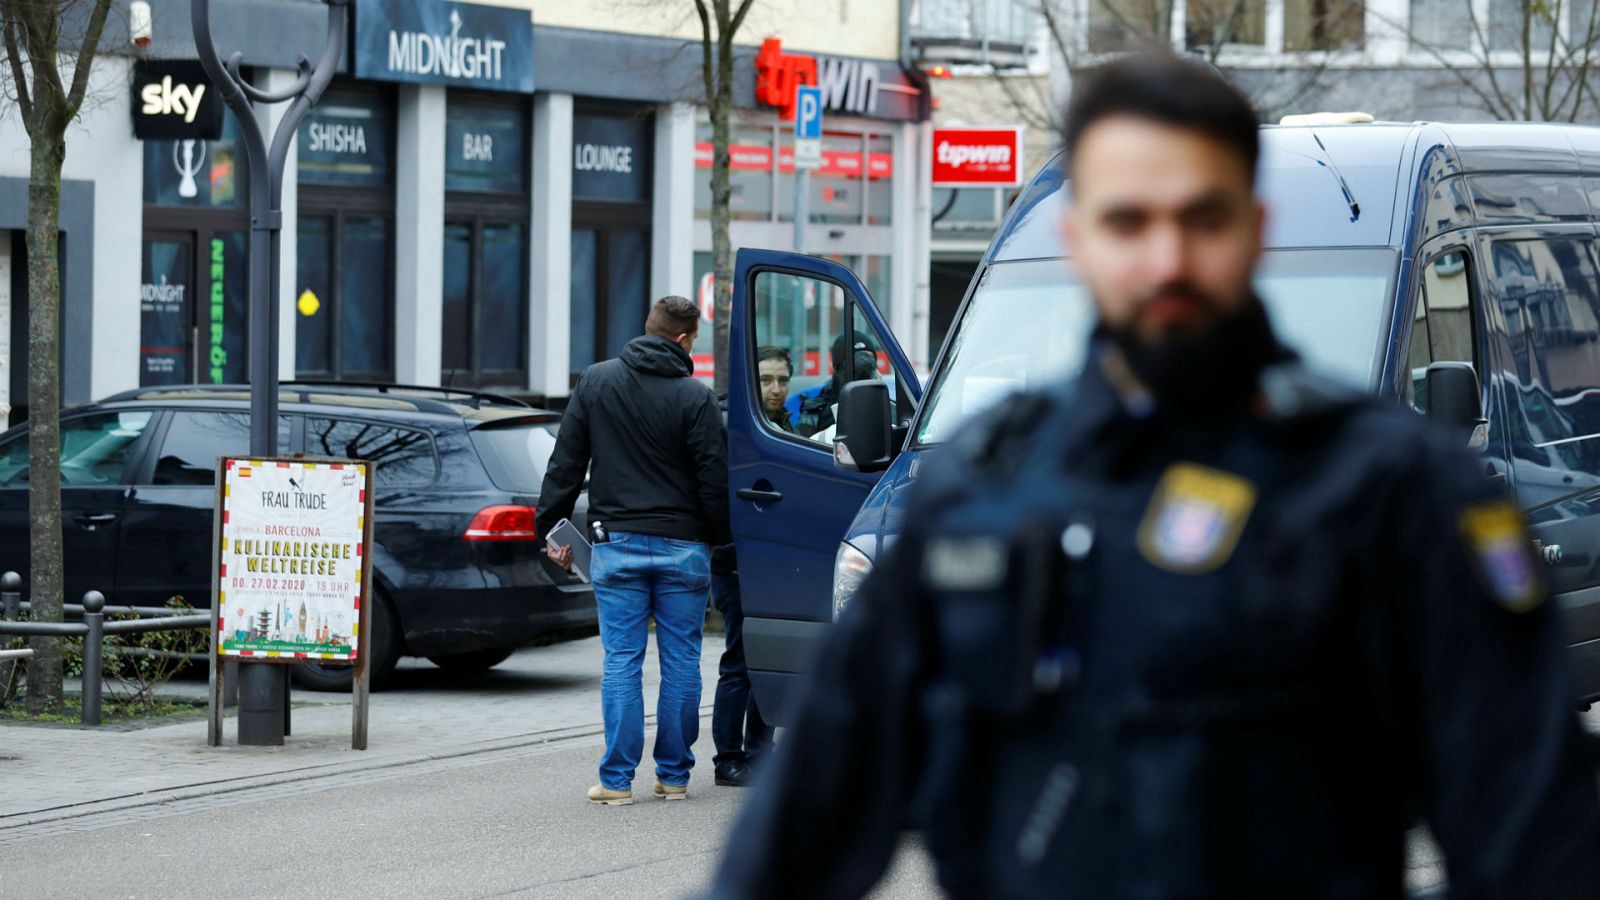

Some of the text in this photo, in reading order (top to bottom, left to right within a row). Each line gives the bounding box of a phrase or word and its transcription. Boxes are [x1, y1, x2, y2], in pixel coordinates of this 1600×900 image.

[389, 28, 505, 80] MIDNIGHT
[141, 74, 206, 123] sky
[801, 93, 817, 136] P
[309, 123, 632, 173] SHISHA BAR LOUNGE
[937, 140, 1011, 168] tipwin
[261, 491, 327, 510] FRAU TRUDE
[265, 525, 321, 537] BARCELONA
[234, 539, 351, 559] KULINARISCHE
[247, 557, 336, 575] WELTREISE
[251, 577, 305, 591] 27.02.2020
[316, 581, 326, 591] 19
[330, 582, 349, 592] UHR
